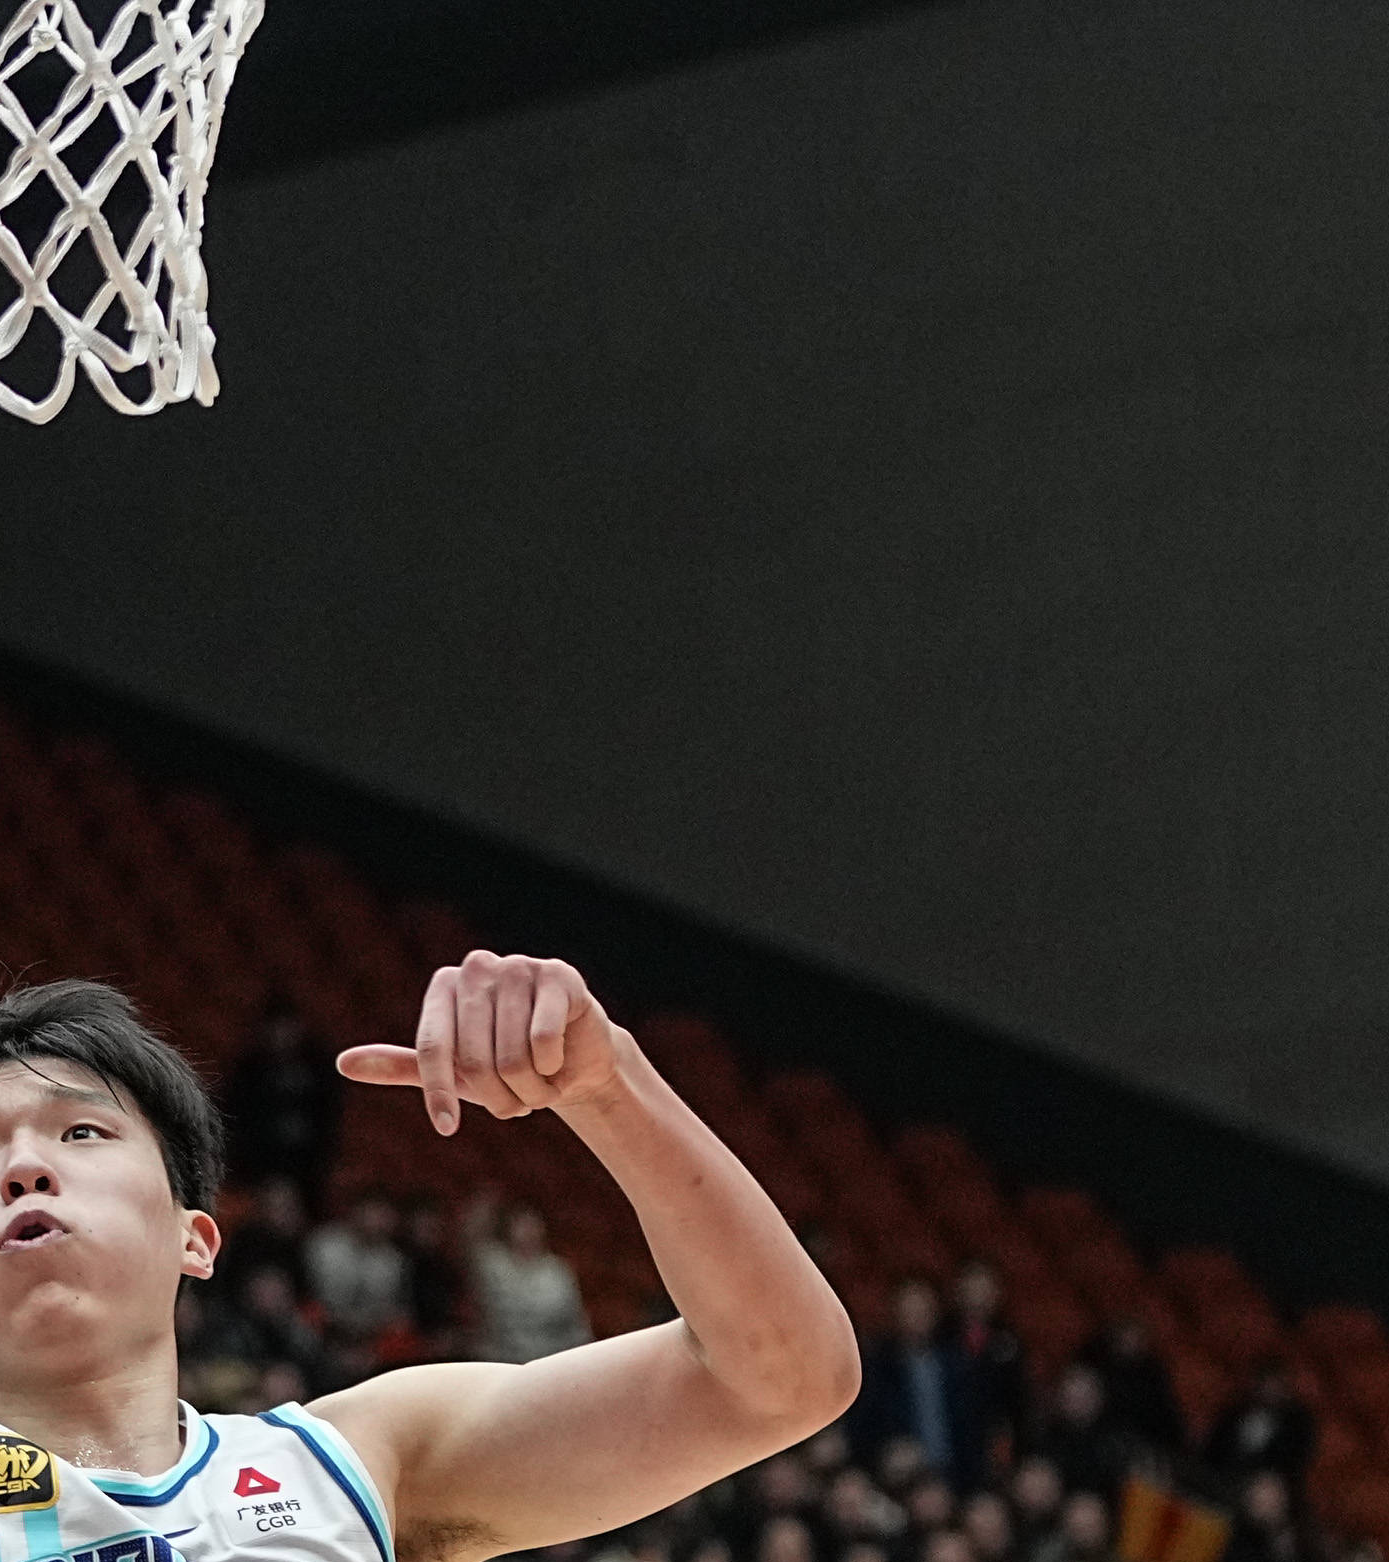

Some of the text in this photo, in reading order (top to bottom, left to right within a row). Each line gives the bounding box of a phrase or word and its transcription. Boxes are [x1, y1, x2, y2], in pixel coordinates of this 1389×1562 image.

[237, 1499, 301, 1521] 广发银行
[256, 1515, 297, 1532] CGB
